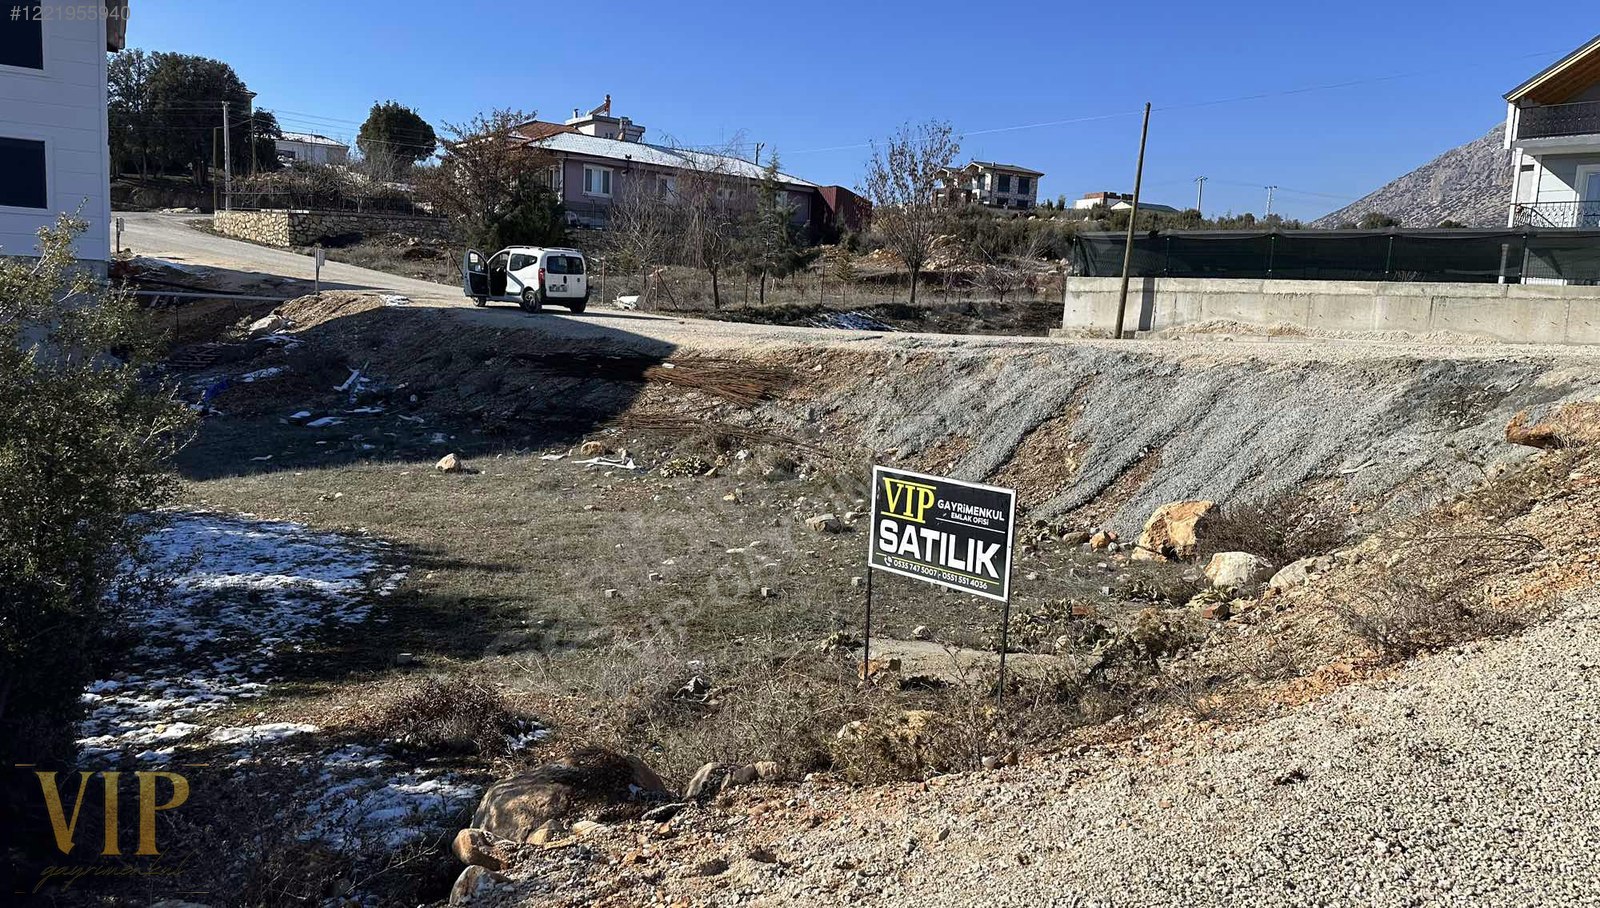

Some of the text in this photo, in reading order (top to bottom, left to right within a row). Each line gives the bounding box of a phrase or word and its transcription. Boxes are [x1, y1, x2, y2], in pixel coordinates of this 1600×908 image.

[882, 477, 936, 523] VIP
[950, 511, 972, 523] EMLAK
[879, 519, 1001, 579] SATILIK
[893, 559, 909, 570] 0535
[909, 563, 920, 572] 747
[921, 566, 937, 577] 5007
[942, 572, 958, 582] 0551
[958, 576, 969, 585] 551
[970, 579, 988, 590] 4036
